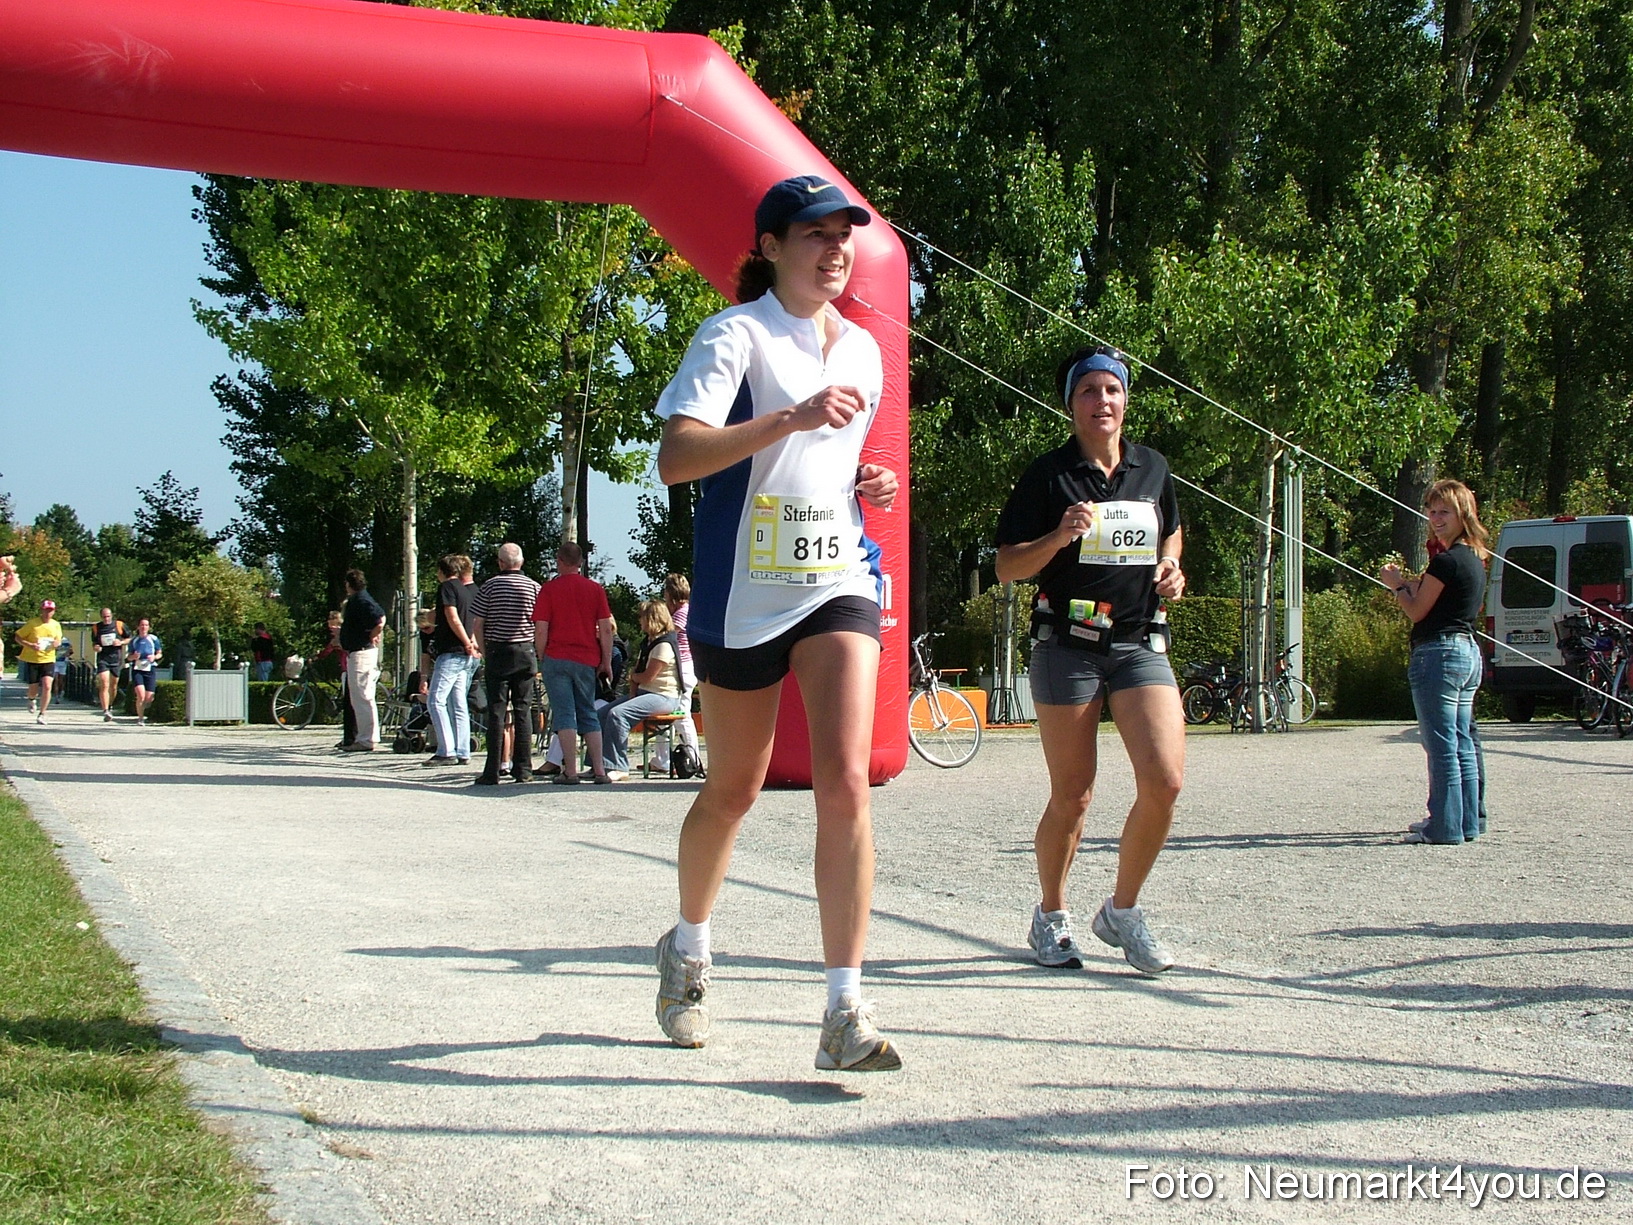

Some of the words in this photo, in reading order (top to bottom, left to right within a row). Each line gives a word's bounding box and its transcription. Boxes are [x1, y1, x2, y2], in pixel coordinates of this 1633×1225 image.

[783, 504, 835, 522] Stefanie
[1103, 508, 1129, 520] Jutta
[756, 529, 764, 542] D
[1111, 529, 1146, 547] 662
[793, 536, 839, 561] 815
